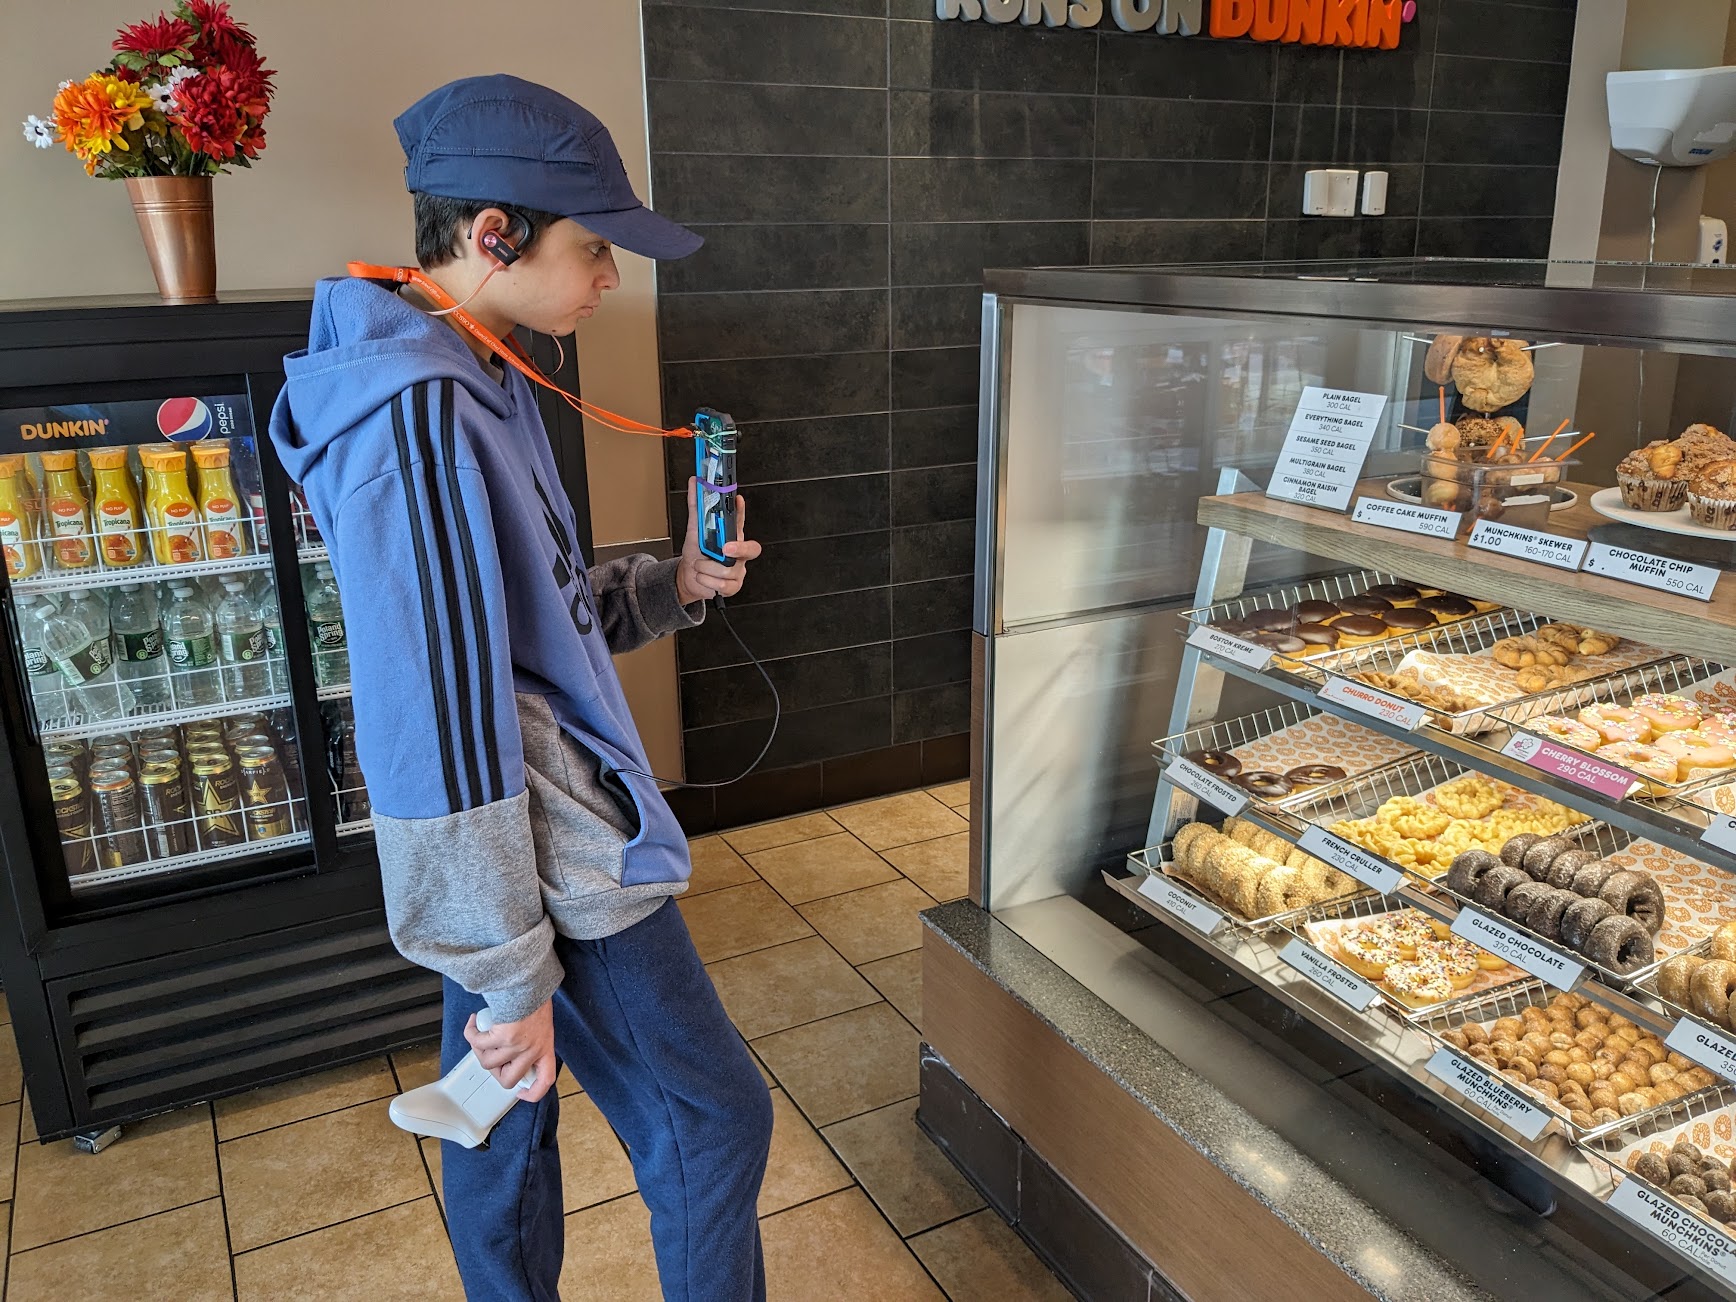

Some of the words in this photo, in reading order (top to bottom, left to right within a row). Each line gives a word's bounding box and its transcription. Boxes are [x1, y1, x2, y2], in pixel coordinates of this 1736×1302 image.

[1322, 393, 1340, 401] PLAIN
[1342, 395, 1361, 404] BAGEL
[214, 403, 231, 434] pepsi
[1305, 414, 1342, 424] EVERYTHING
[1344, 419, 1363, 428] BAGEL
[21, 419, 109, 440] DUNKIN'
[1296, 436, 1319, 445] SESAME
[1336, 442, 1356, 451] BAGEL
[1289, 458, 1326, 469] MULTIGRAIN
[1326, 464, 1346, 473] BAGEL
[1315, 470, 1326, 478] CAL
[1283, 476, 1316, 488] CINNAMON
[1317, 483, 1337, 492] RAISIN
[1298, 487, 1317, 496] BAGEL
[1294, 492, 1305, 500] 320
[1306, 495, 1317, 503] CAL
[103, 518, 130, 527] Tropicana
[1366, 503, 1394, 516] COFFEE
[1396, 508, 1416, 518] CAKE
[1416, 511, 1448, 524] MUFFIN
[55, 520, 83, 528] Tropicana
[1418, 522, 1433, 531] 590
[1434, 525, 1450, 535] CAL
[1473, 533, 1501, 546] $1.00
[1538, 538, 1573, 552] SKEWER
[1524, 544, 1555, 559] 160-170
[1555, 552, 1572, 563] CAL
[1609, 548, 1667, 569] CHOCOLATE
[1669, 562, 1693, 575] CHIP
[1629, 562, 1666, 578] MUFFIN
[1665, 577, 1684, 589] 550
[1685, 582, 1705, 595] CAL
[317, 622, 342, 634] Poland
[319, 630, 344, 641] Spring
[1209, 634, 1234, 647] BOSTON
[1234, 642, 1254, 654] KREME
[1225, 648, 1236, 656] CAL
[1342, 686, 1374, 702] CHURRO
[1374, 698, 1405, 712] DONUT
[1379, 708, 1395, 718] 230
[1395, 715, 1411, 726] CAL
[1541, 747, 1580, 766] CHERRY
[1580, 762, 1629, 785] BLOSSOM
[1557, 763, 1576, 775] 290
[1577, 771, 1596, 784] CAL
[1179, 763, 1211, 787] CHOCOLATE
[1211, 784, 1237, 802] FROSTED
[1190, 780, 1201, 789] 260
[1201, 786, 1212, 797] CAL
[1322, 837, 1351, 857] FRENCH
[1350, 853, 1382, 874] CRULLER
[1331, 853, 1344, 864] 230
[1344, 862, 1358, 873] CAL
[1168, 891, 1196, 911] COCONUT
[1176, 905, 1187, 915] CAL
[1472, 919, 1507, 940] GLAZED
[1507, 937, 1565, 970] CHOCOLATE
[1493, 941, 1510, 953] 370
[1510, 949, 1527, 964] CAL
[1301, 950, 1327, 972] VANILLA
[1327, 968, 1358, 991] FROSTED
[1308, 966, 1322, 978] 260
[1322, 975, 1335, 987] CAL
[1451, 1059, 1483, 1082] GLAZED
[1483, 1080, 1532, 1114] BLUEBERRY
[1464, 1088, 1476, 1098] 60
[1476, 1096, 1492, 1111] CAL
[1637, 1190, 1680, 1219] GLAZED
[1661, 1229, 1677, 1241] 60
[1678, 1239, 1700, 1258] CAL
[1710, 1258, 1727, 1270] Donut
